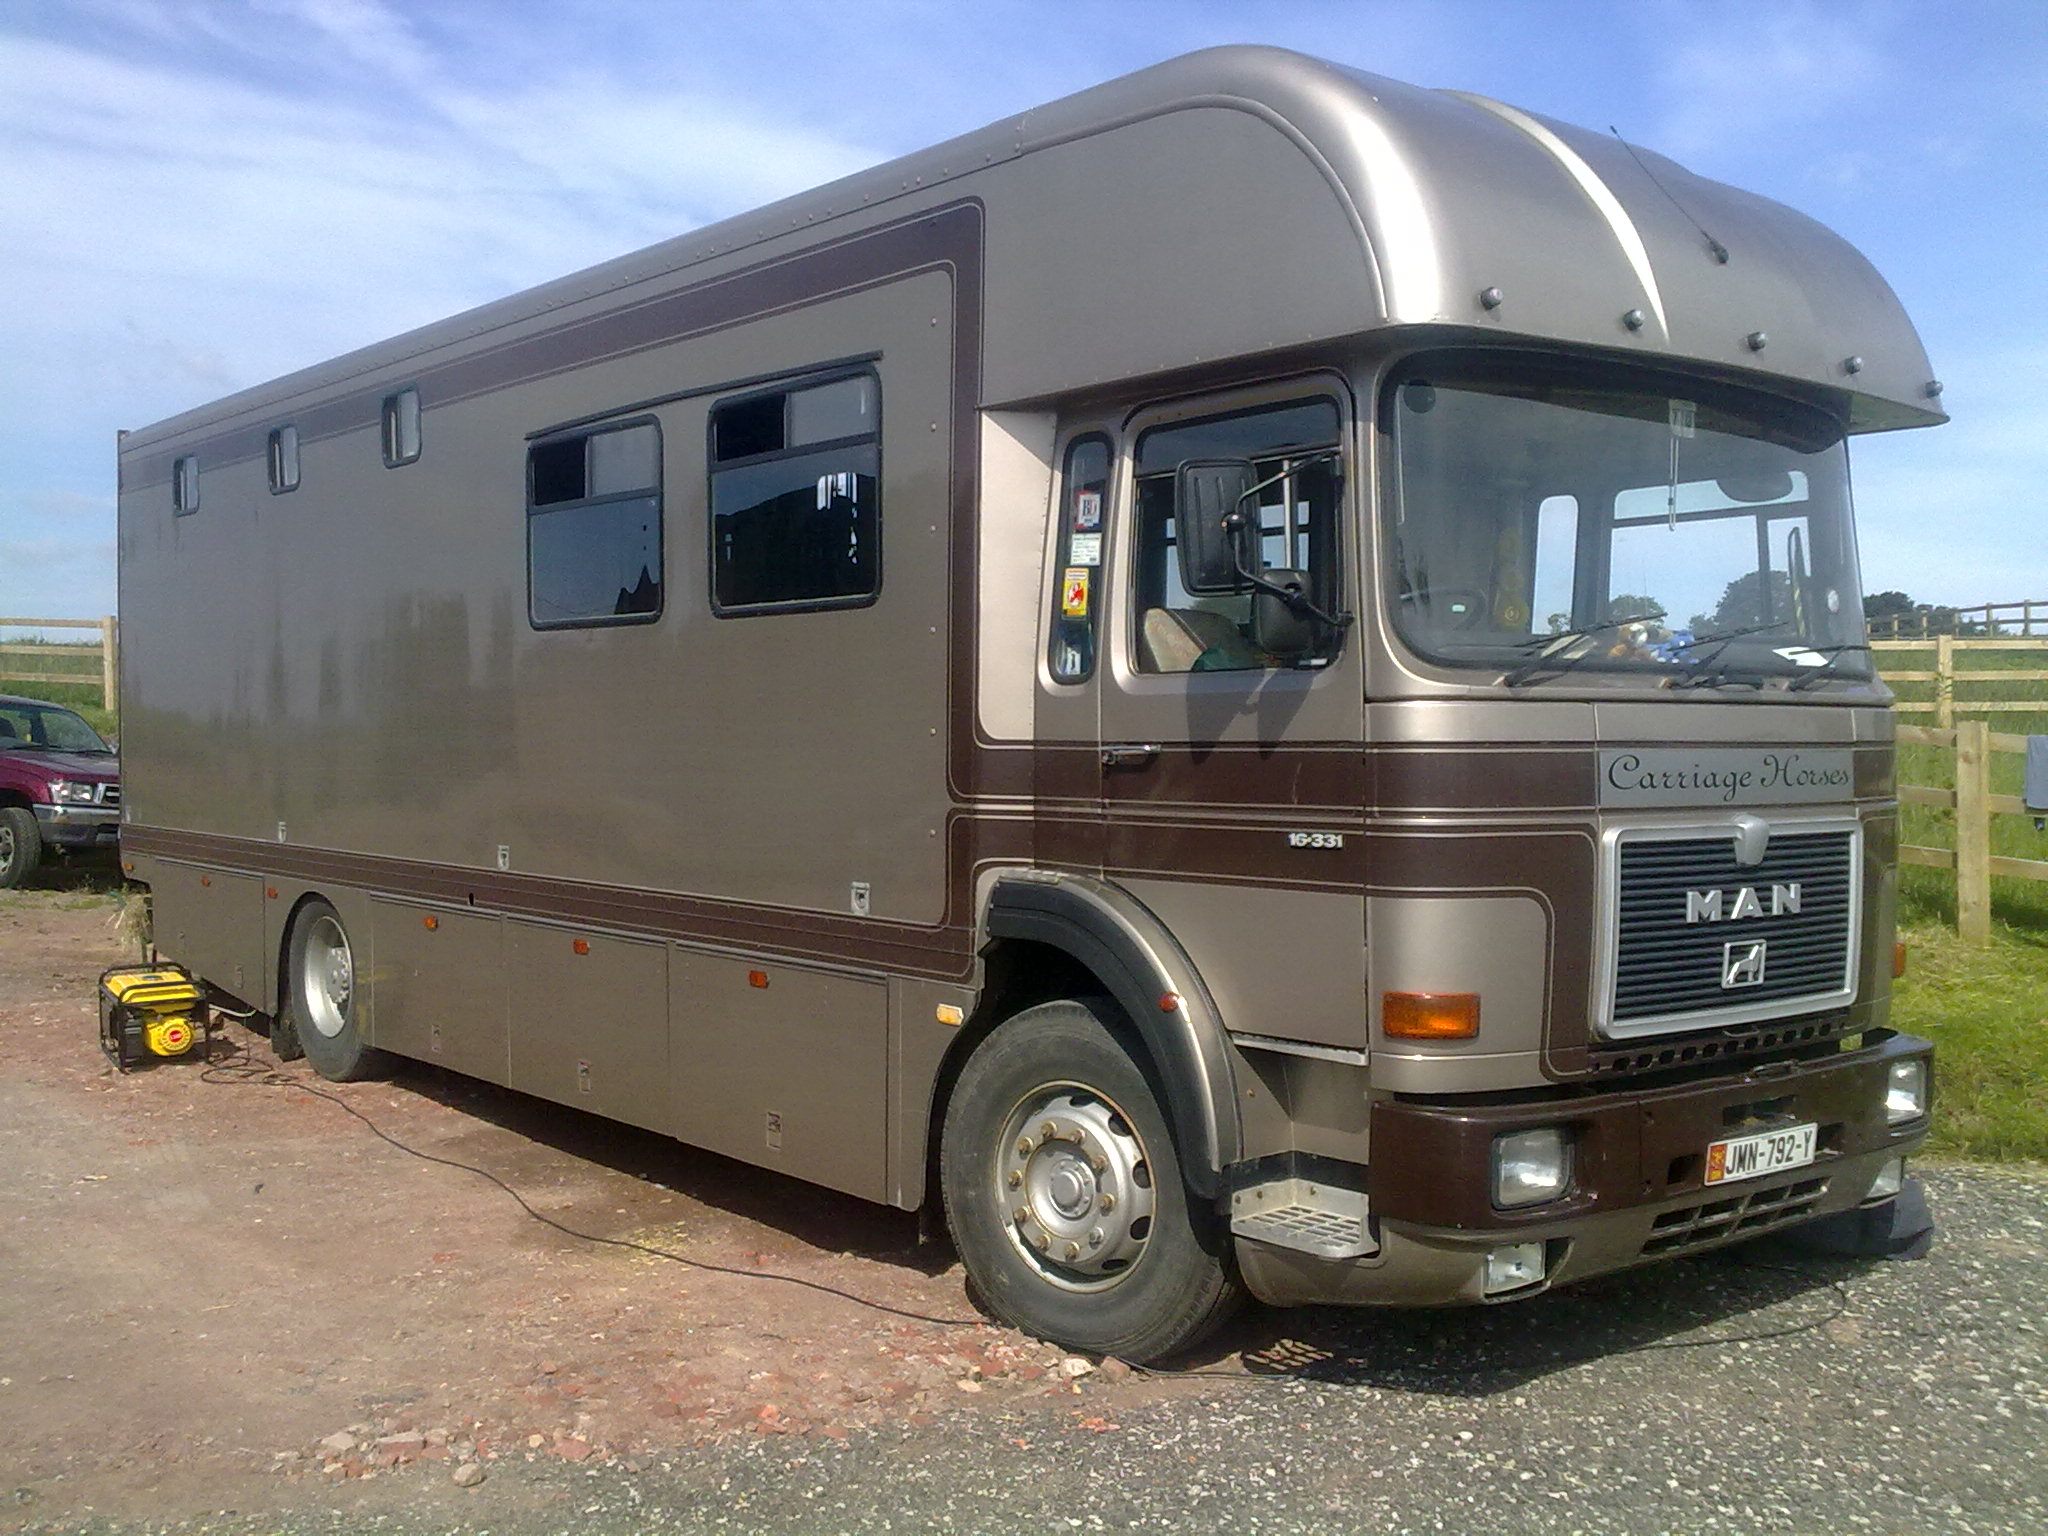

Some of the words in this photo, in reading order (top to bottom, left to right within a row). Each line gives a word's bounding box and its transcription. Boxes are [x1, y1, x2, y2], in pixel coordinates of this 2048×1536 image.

[1608, 754, 1752, 801] Carriage
[1760, 754, 1849, 788] Horses
[1686, 883, 1802, 923] MAN
